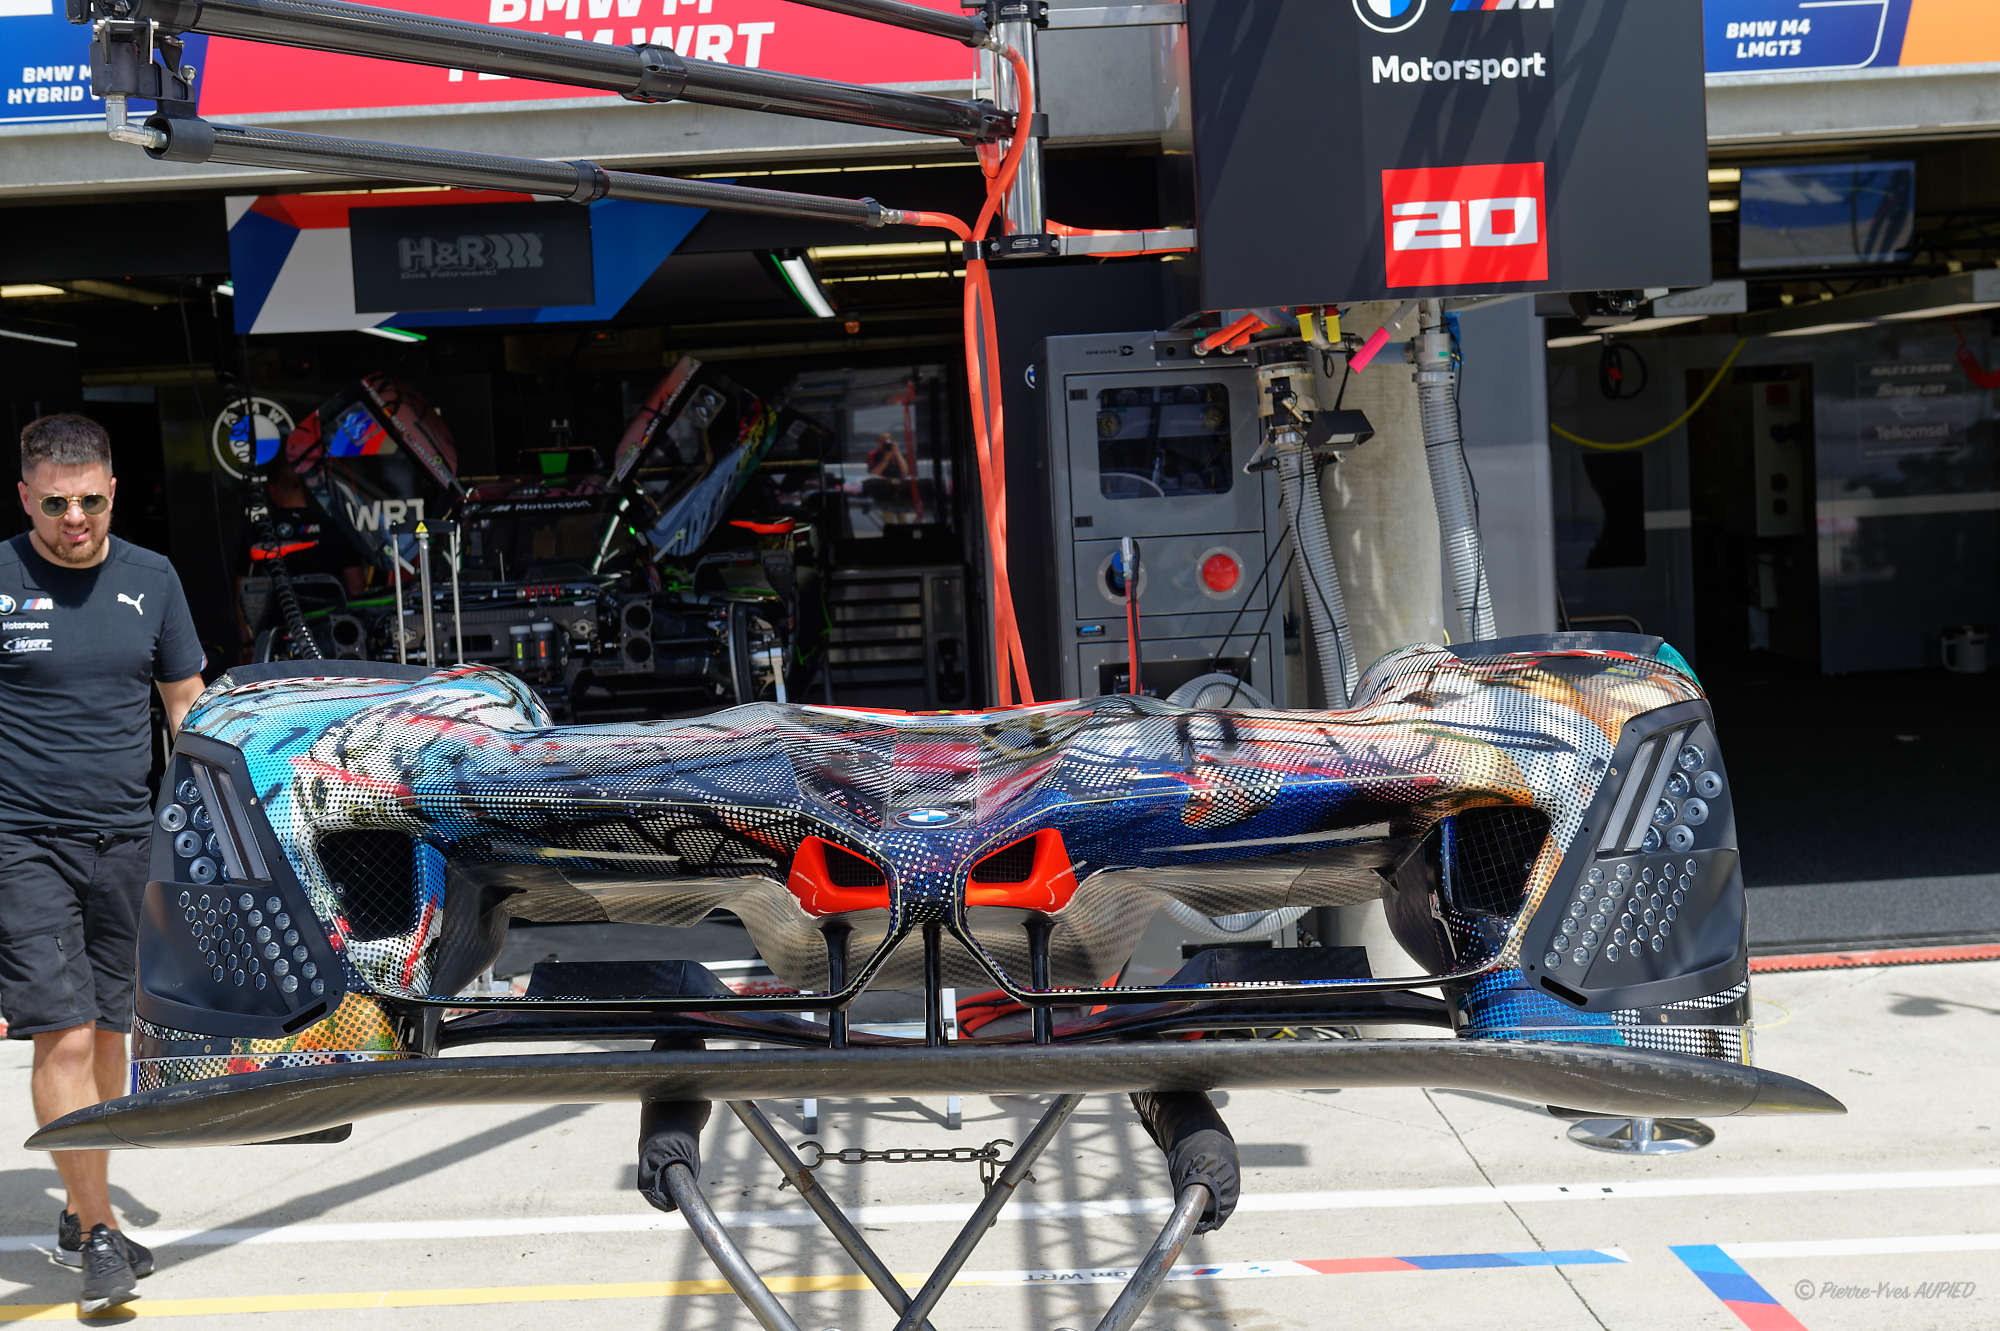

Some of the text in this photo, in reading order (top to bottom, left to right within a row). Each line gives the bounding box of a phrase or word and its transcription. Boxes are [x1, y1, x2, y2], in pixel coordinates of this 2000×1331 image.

[1726, 18, 1811, 39] BMW M4
[1736, 39, 1802, 58] LMGT3
[22, 65, 75, 83] BMW
[1372, 52, 1546, 85] Motorsport
[7, 85, 84, 104] HYBRID
[1391, 197, 1539, 251] 20
[2, 621, 49, 631] Motorsport
